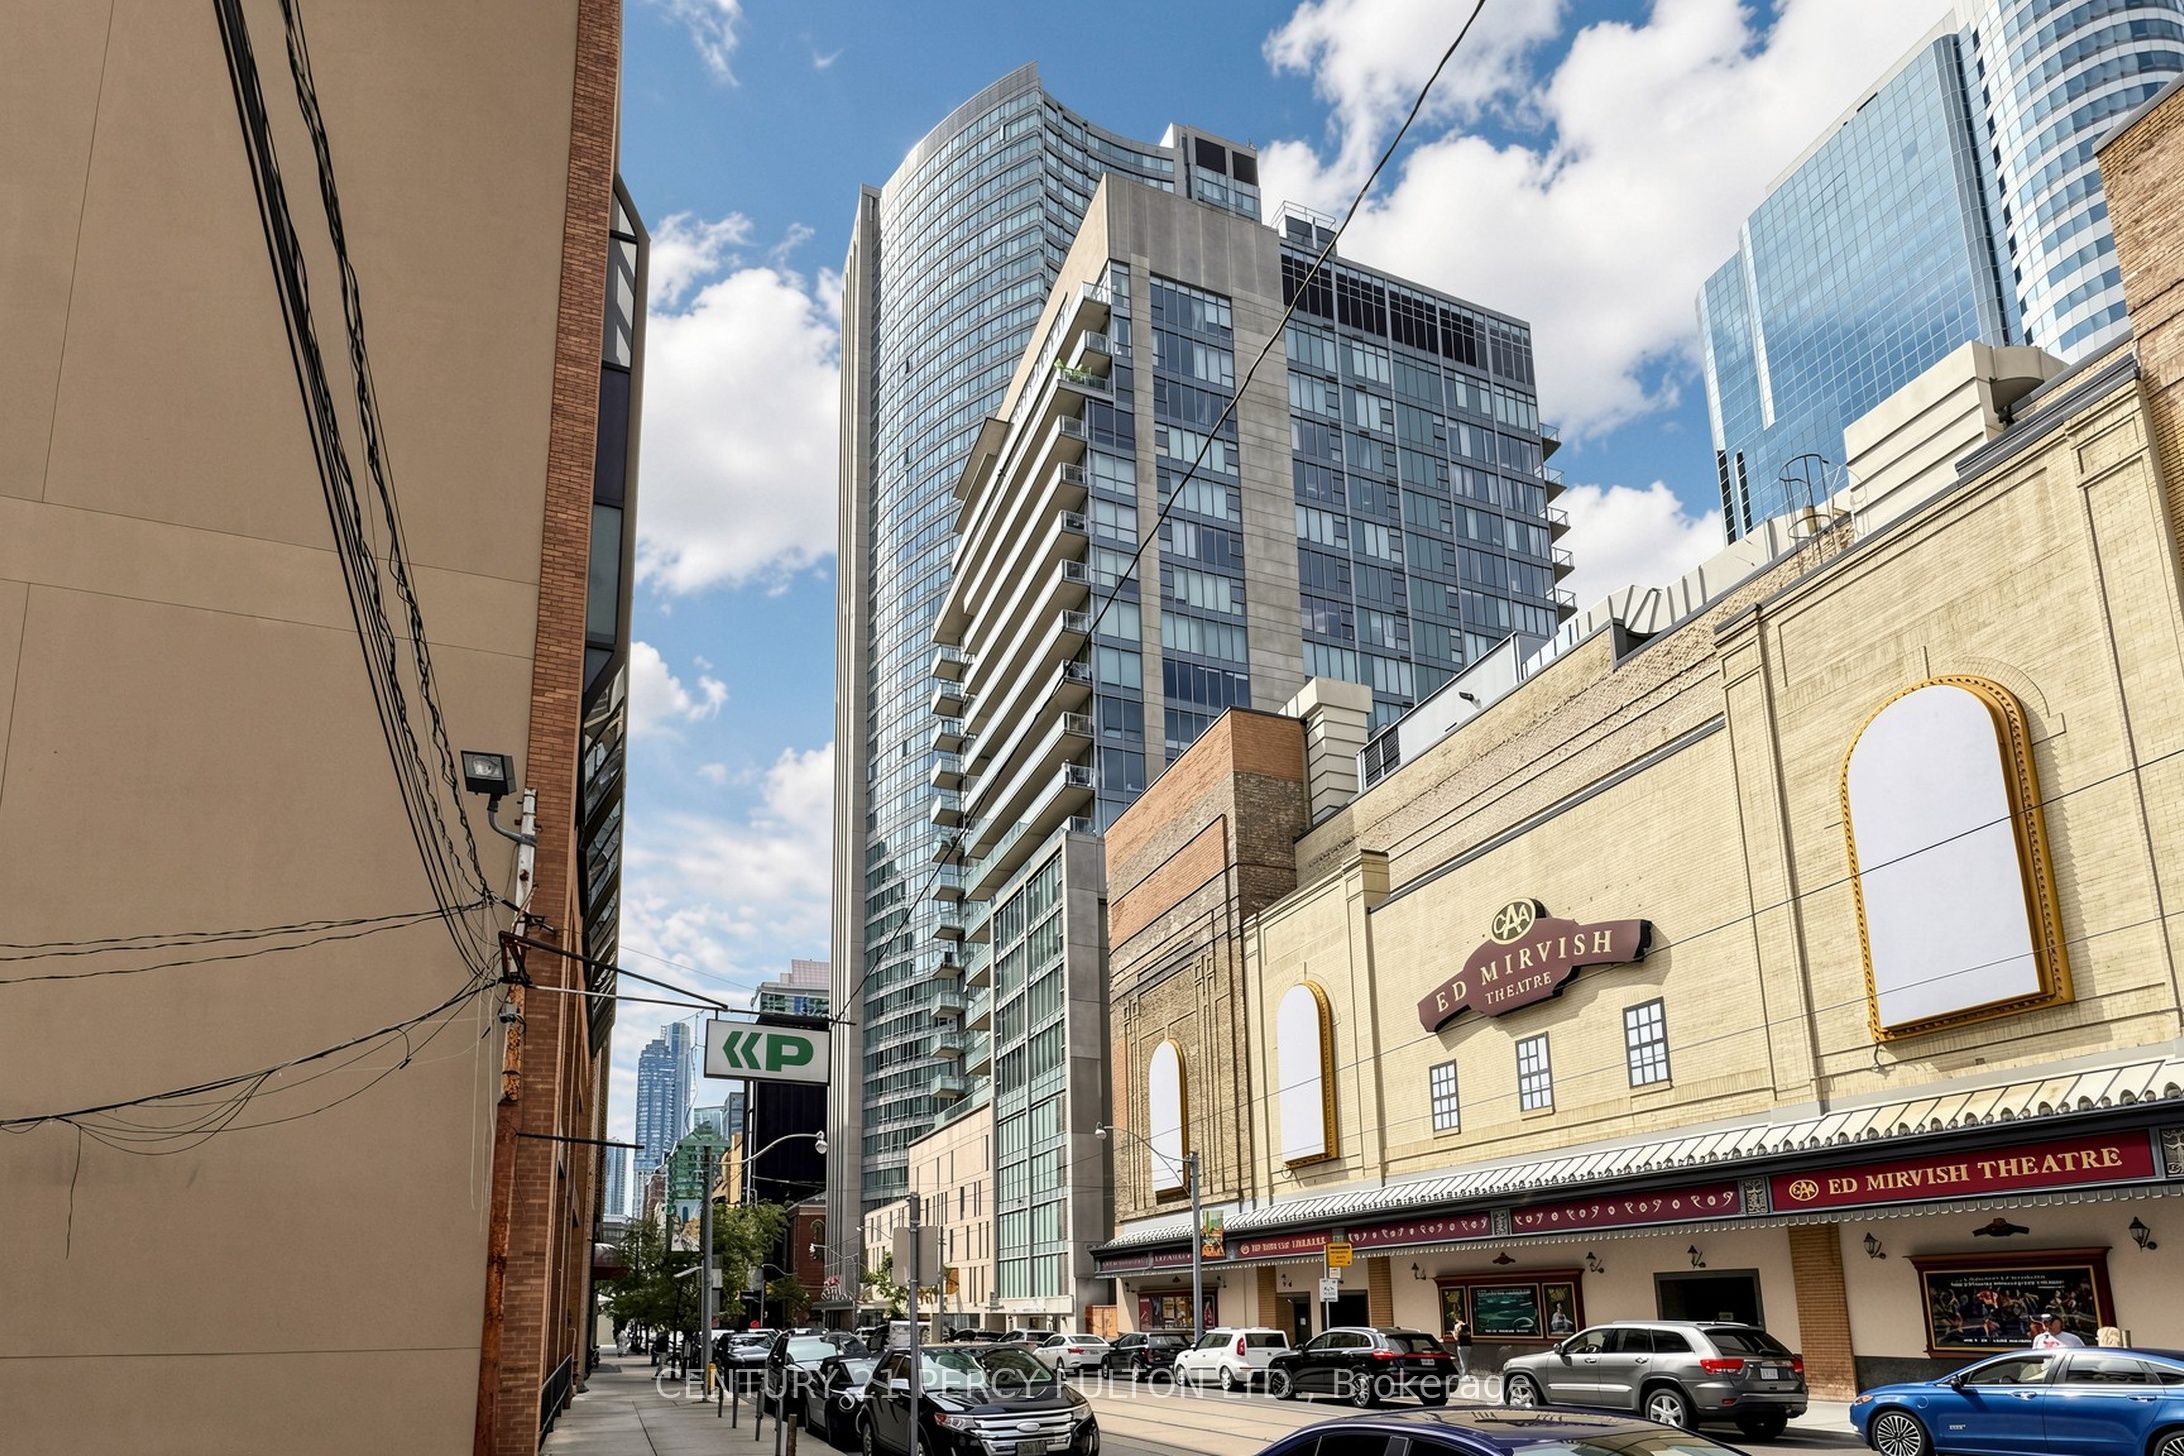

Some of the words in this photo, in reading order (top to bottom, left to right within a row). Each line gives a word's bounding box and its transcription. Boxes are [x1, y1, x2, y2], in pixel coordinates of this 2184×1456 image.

[1493, 903, 1530, 940] CAA
[1436, 980, 1467, 1013] ED
[1480, 930, 1612, 986] MIRVISH
[1485, 971, 1552, 1005] THEATRE
[1828, 1177, 1858, 1195] ED
[1866, 1163, 1969, 1192] MIRVISH
[1977, 1146, 2122, 1179] THEATRE
